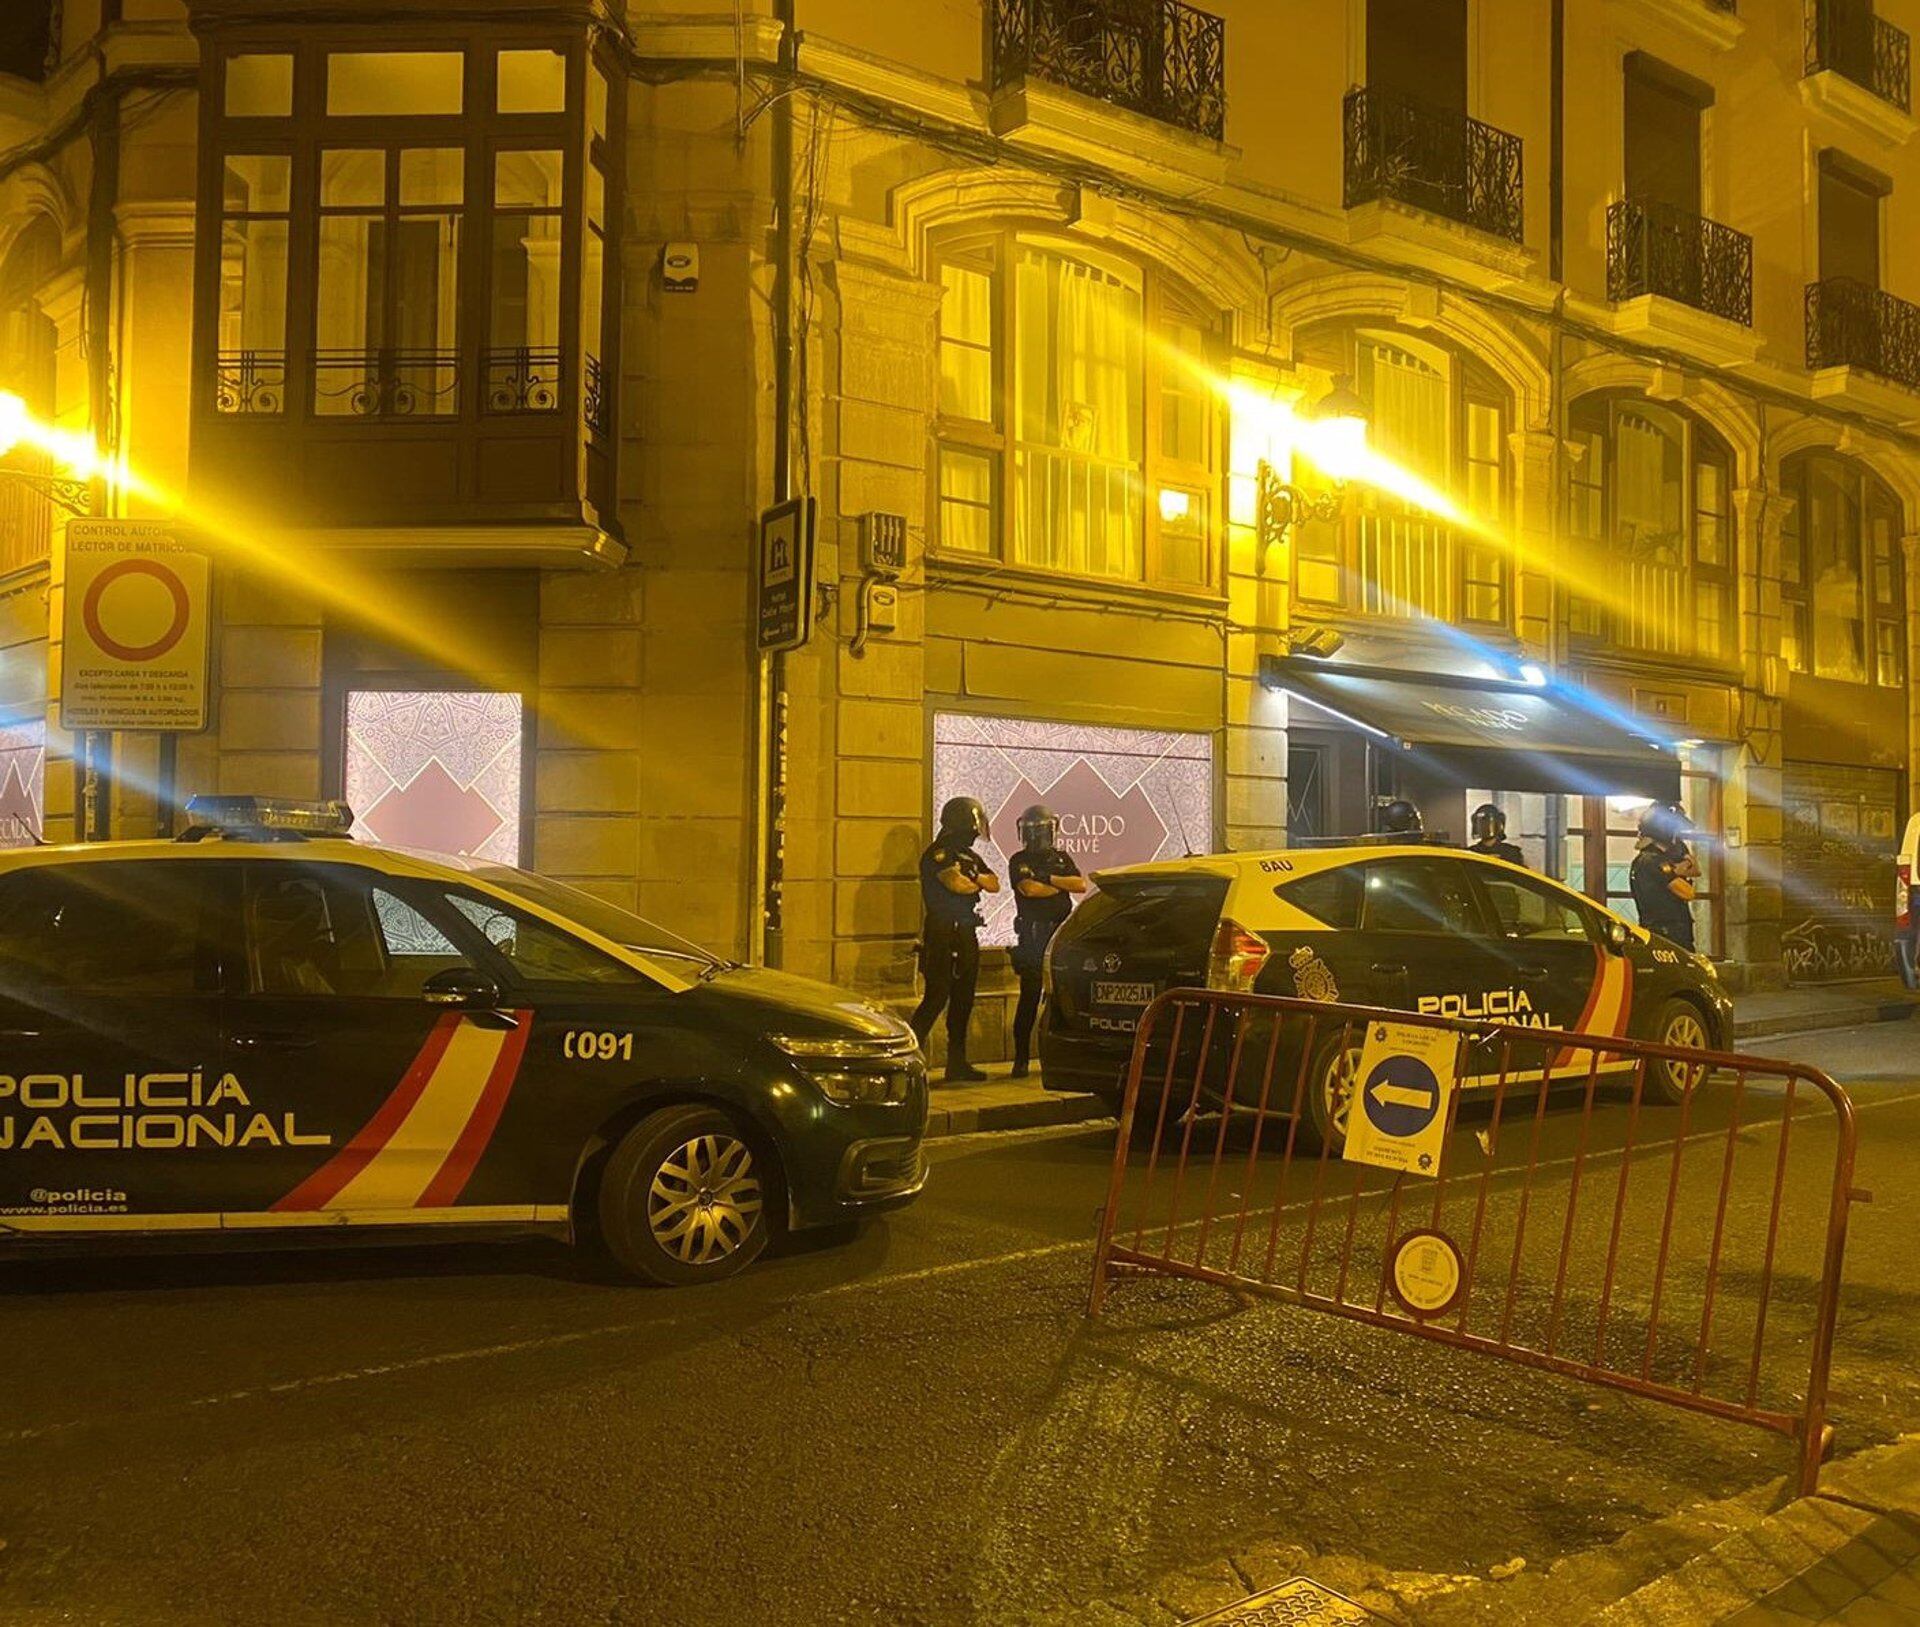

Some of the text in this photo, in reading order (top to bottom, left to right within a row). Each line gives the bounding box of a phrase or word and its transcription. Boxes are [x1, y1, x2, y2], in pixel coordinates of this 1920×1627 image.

[73, 525, 127, 537] CONTROL
[71, 541, 114, 552] LECTOR
[117, 541, 132, 552] DE
[1054, 813, 1126, 837] CADO
[1056, 835, 1101, 853] PRIVÉ
[1417, 986, 1533, 1018] POLICÍA
[30, 1188, 127, 1203] @policia
